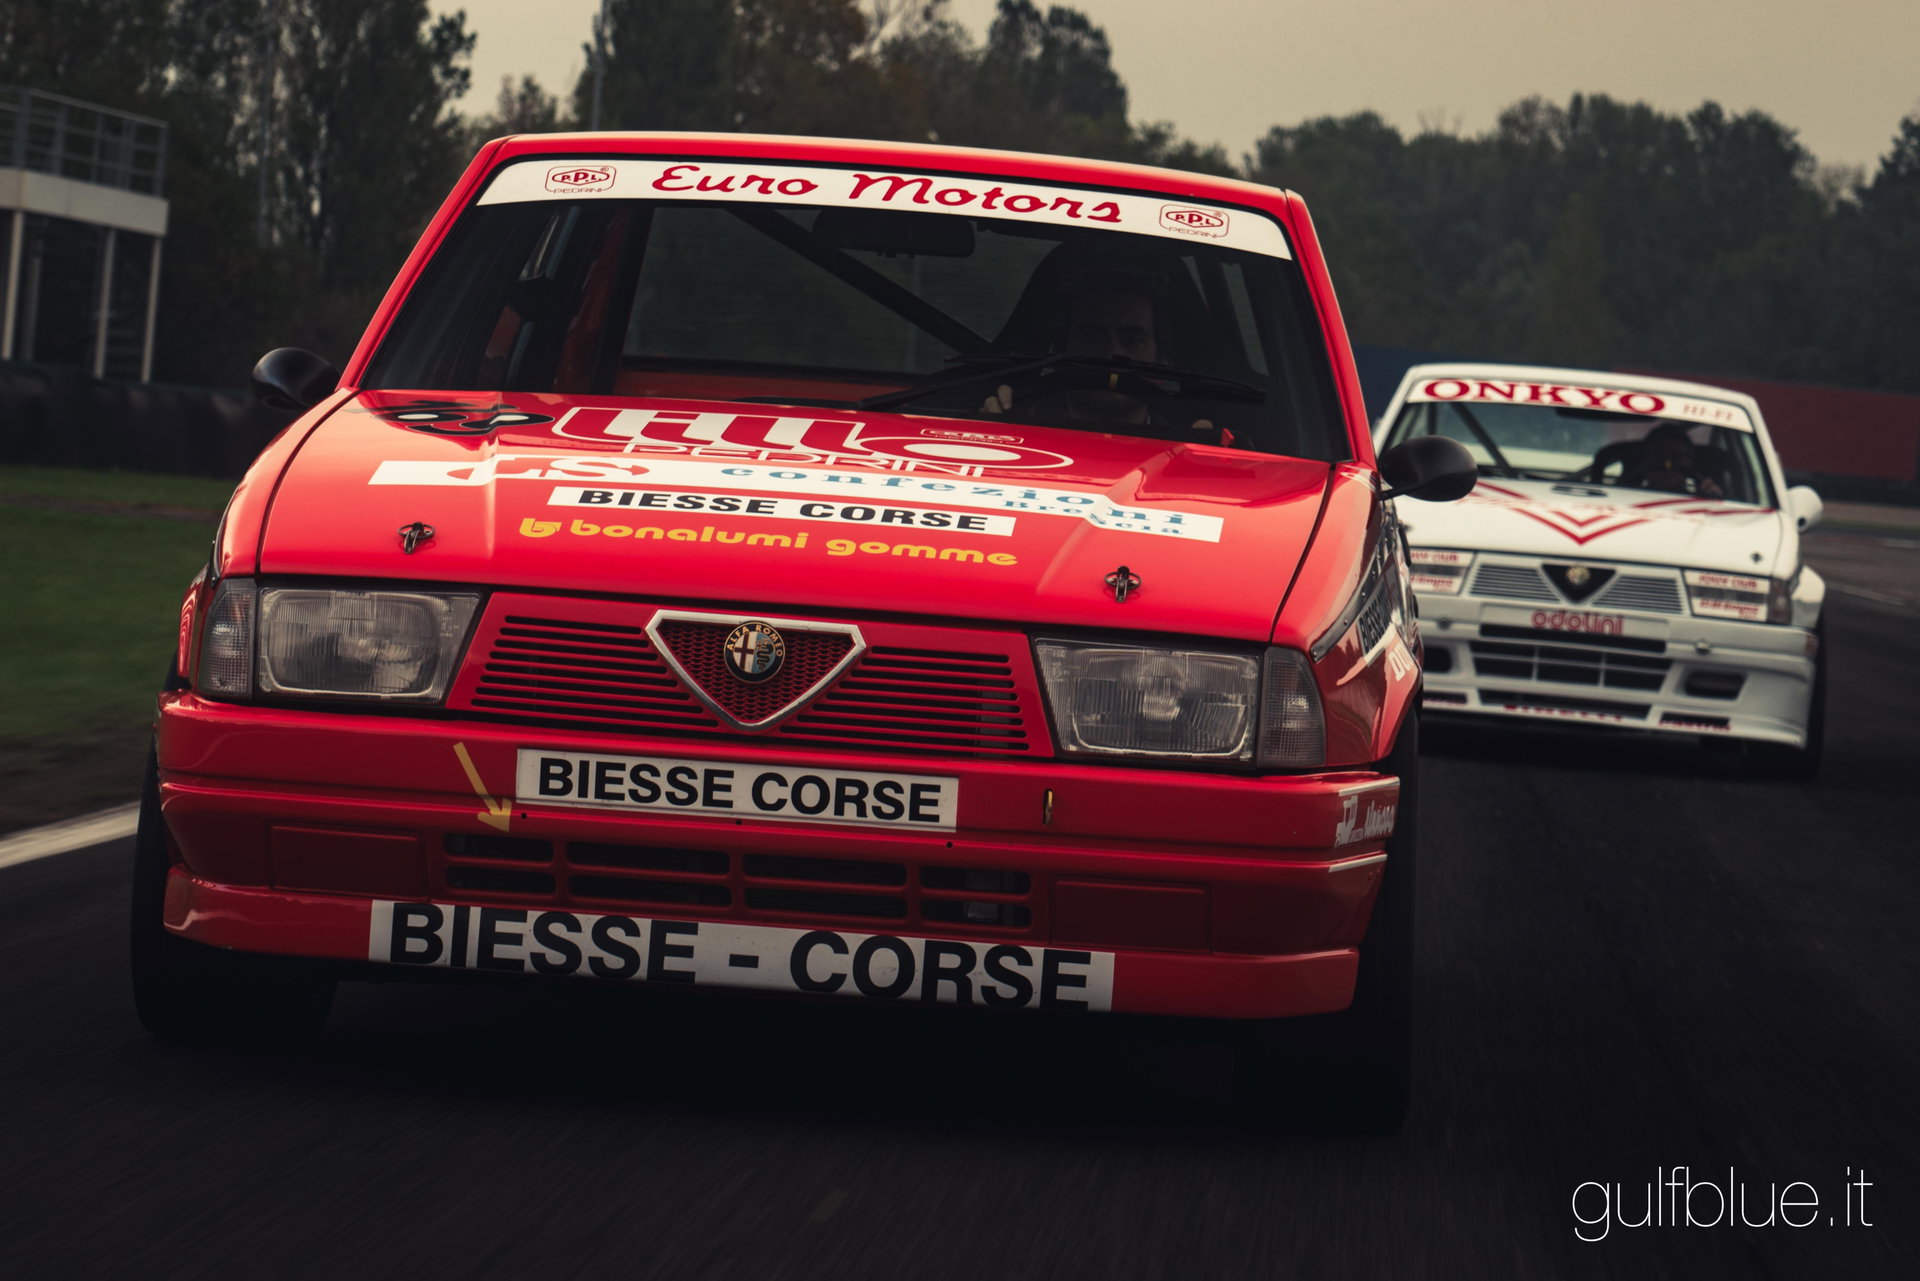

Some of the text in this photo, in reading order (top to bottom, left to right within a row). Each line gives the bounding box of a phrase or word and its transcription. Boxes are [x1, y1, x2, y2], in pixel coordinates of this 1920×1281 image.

[652, 165, 1123, 225] Euro Motors
[1424, 379, 1665, 415] ONKYO
[622, 442, 984, 478] PEDRINI
[578, 489, 988, 532] BIESSE CORSE
[720, 467, 1187, 526] confezioni
[570, 519, 809, 549] bonalumi
[826, 537, 1018, 566] gomme
[726, 624, 783, 657] ALFA ROMEO
[538, 756, 941, 823] BIESSE CORSE
[389, 902, 699, 984] BIESSE
[790, 930, 1092, 1012] CORSE
